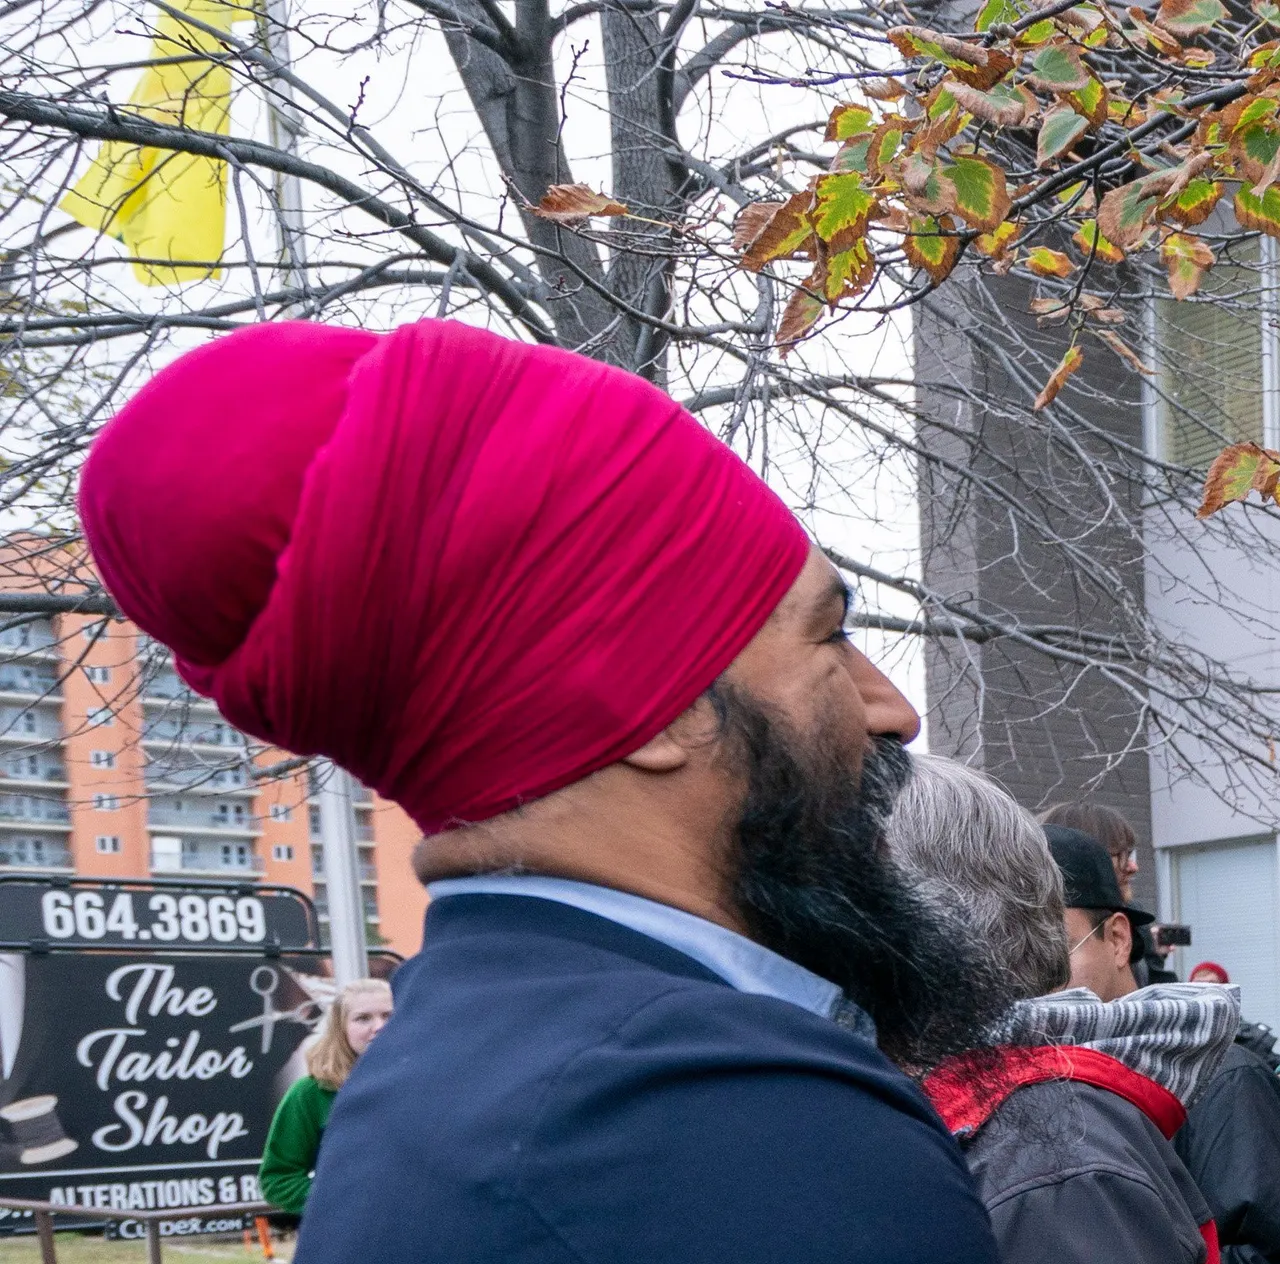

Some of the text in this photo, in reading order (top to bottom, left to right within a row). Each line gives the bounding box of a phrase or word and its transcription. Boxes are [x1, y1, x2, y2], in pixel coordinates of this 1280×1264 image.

[41, 890, 266, 943] 664.3869
[104, 962, 217, 1026] The
[76, 1028, 254, 1092] Tailor
[92, 1090, 249, 1159] Shop
[218, 1176, 238, 1202] &
[240, 1174, 263, 1201] R
